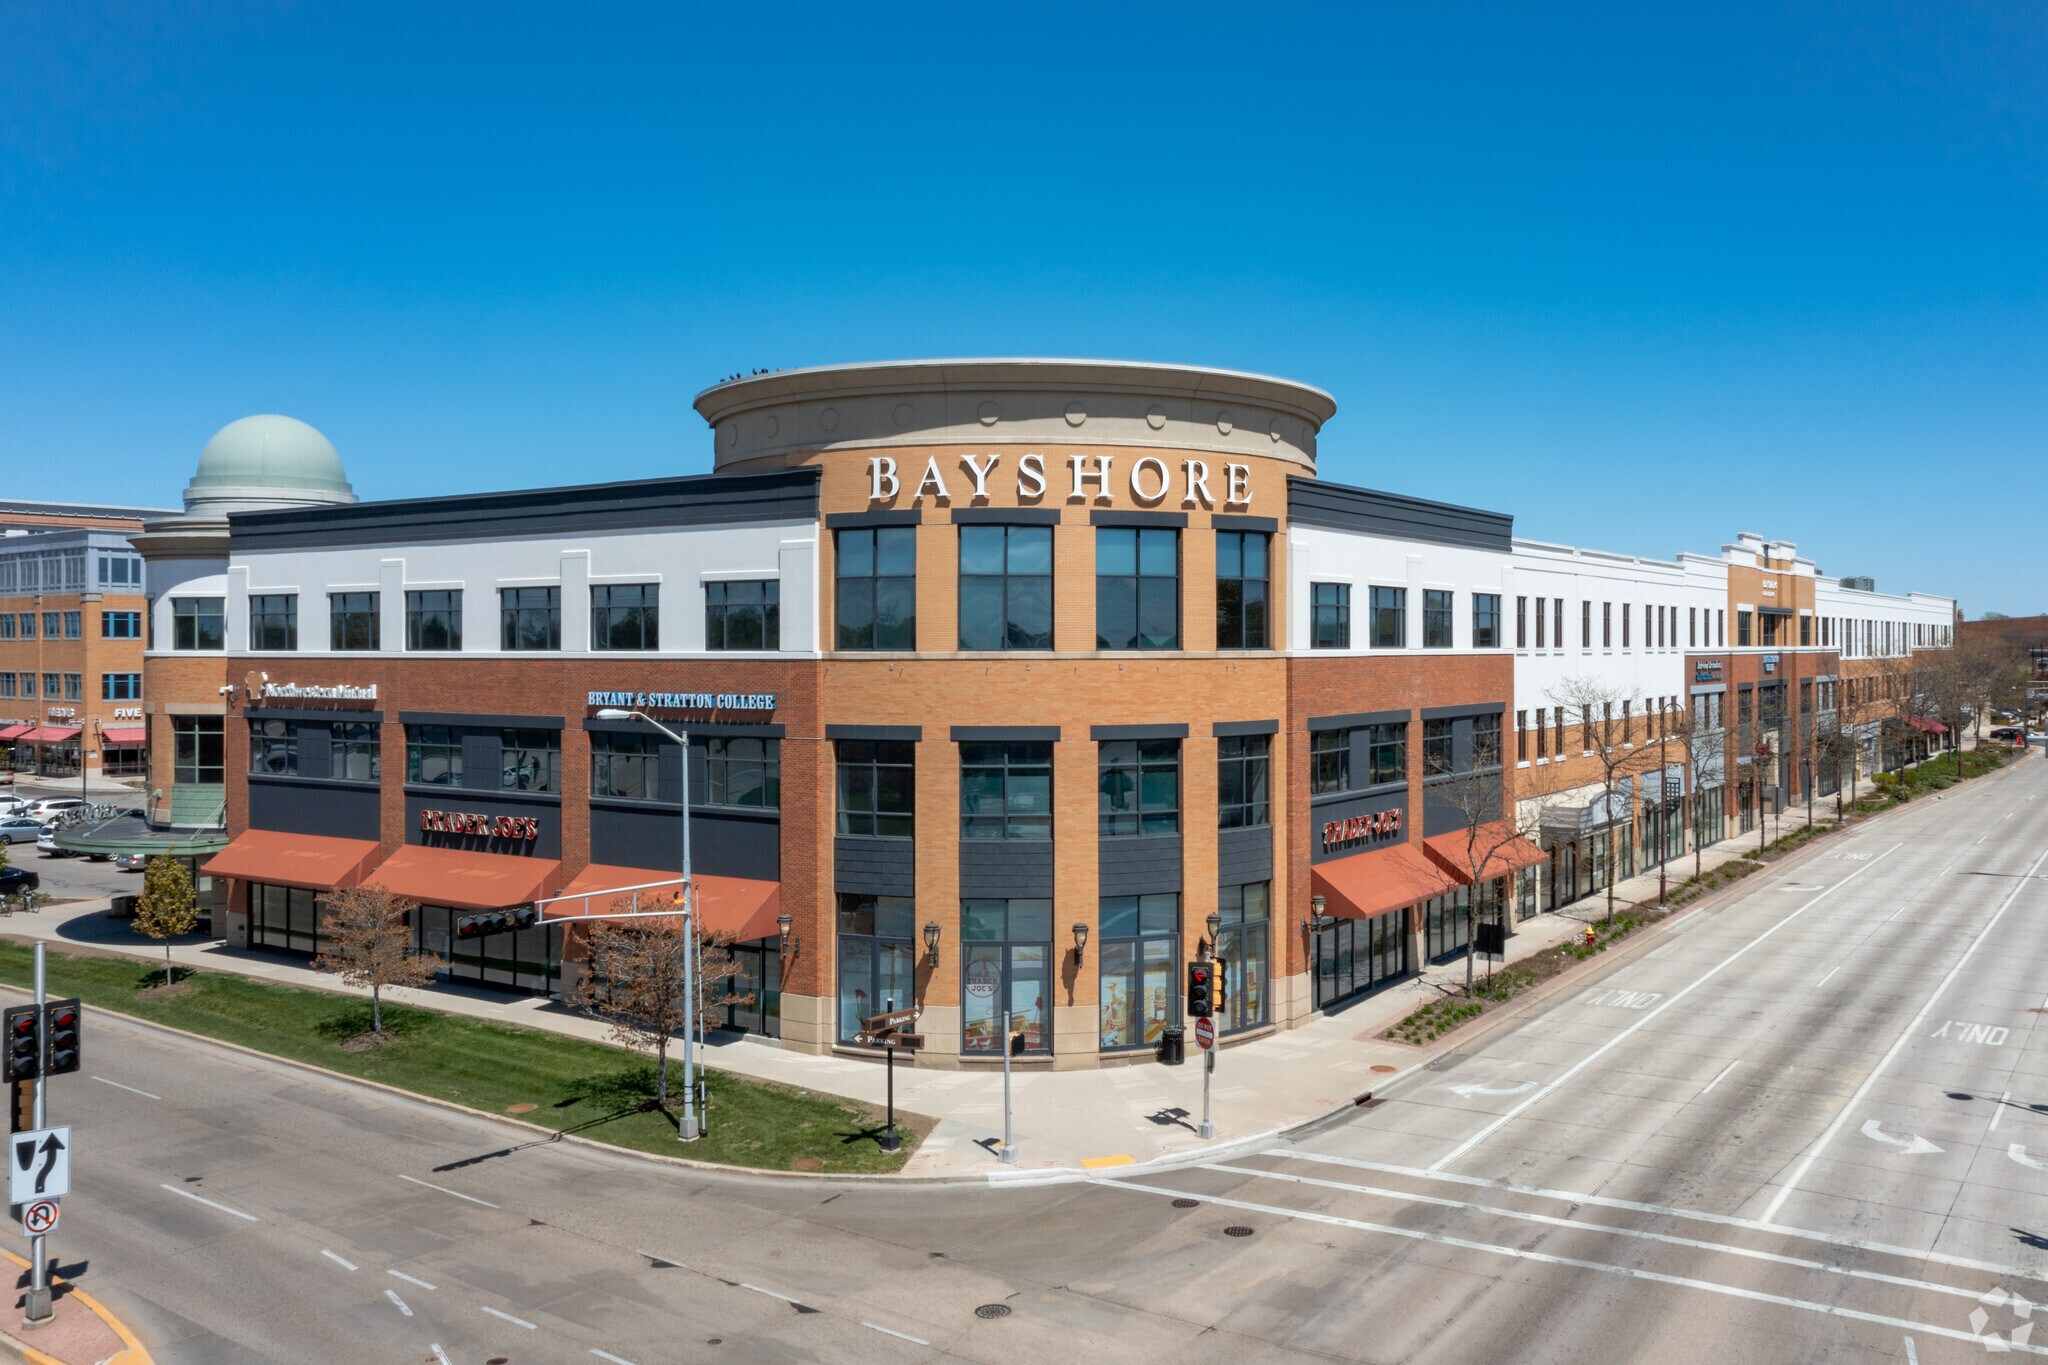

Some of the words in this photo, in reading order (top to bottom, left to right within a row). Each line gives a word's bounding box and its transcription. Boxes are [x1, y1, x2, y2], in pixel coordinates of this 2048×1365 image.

[868, 454, 1252, 504] BAYSHORE
[588, 691, 635, 706] BRYANT
[636, 692, 648, 707] &
[648, 693, 715, 708] STRATTON
[717, 694, 776, 710] COLLEGE
[114, 707, 142, 718] FIVE
[421, 809, 489, 836] TRADER
[491, 815, 538, 840] JOE'S
[1323, 814, 1372, 844] TRADER
[1371, 808, 1402, 833] JOE'S
[1586, 989, 1662, 1009] ONLY
[1197, 1021, 1204, 1029] DO
[1203, 1023, 1212, 1031] NOT
[1930, 1020, 2010, 1046] ONLY
[1198, 1036, 1211, 1045] ENTER
